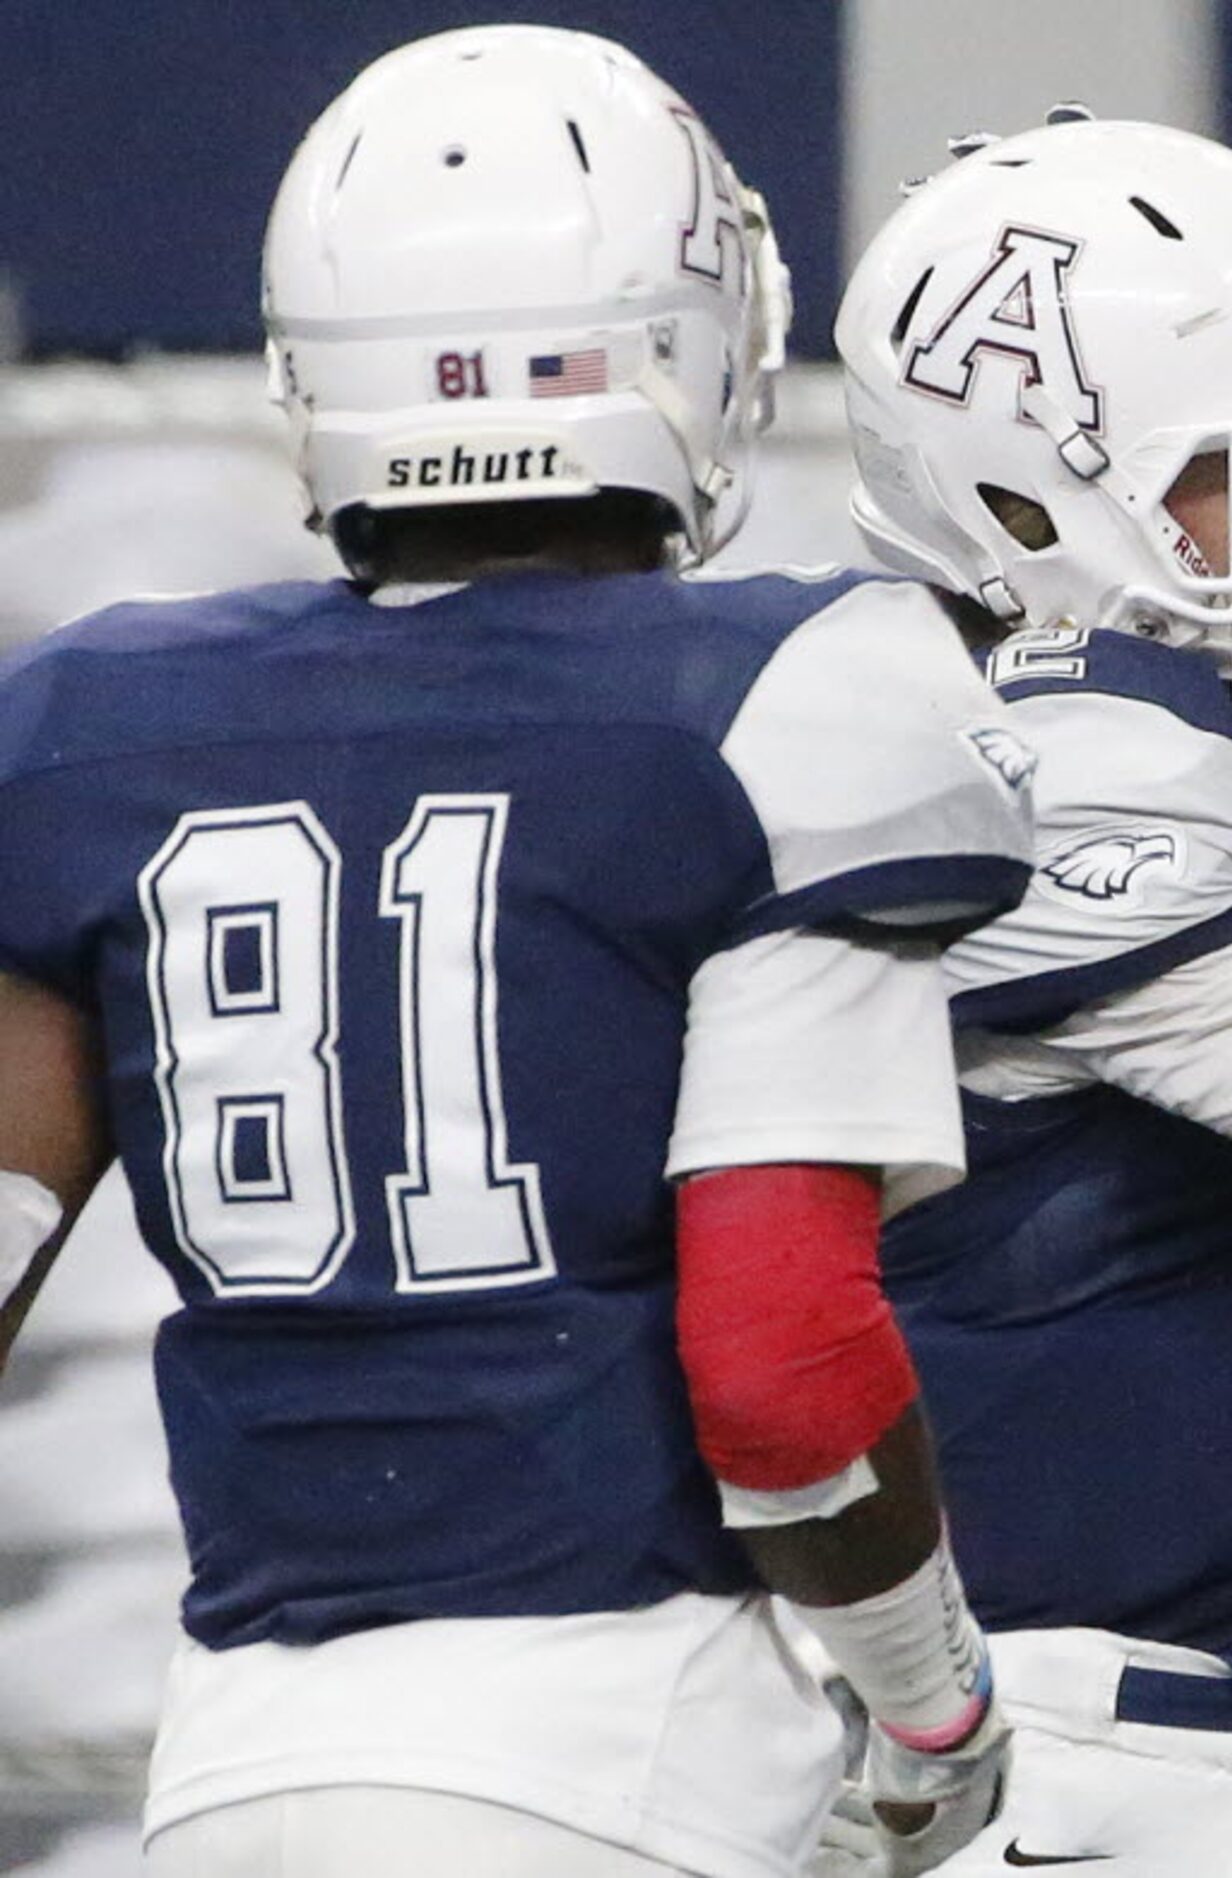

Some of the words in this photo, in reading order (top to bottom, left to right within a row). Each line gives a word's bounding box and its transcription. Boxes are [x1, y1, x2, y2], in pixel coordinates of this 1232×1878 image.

[437, 349, 489, 398] 81
[900, 219, 1106, 435] A
[387, 445, 558, 487] schutt
[137, 793, 557, 1298] 81
